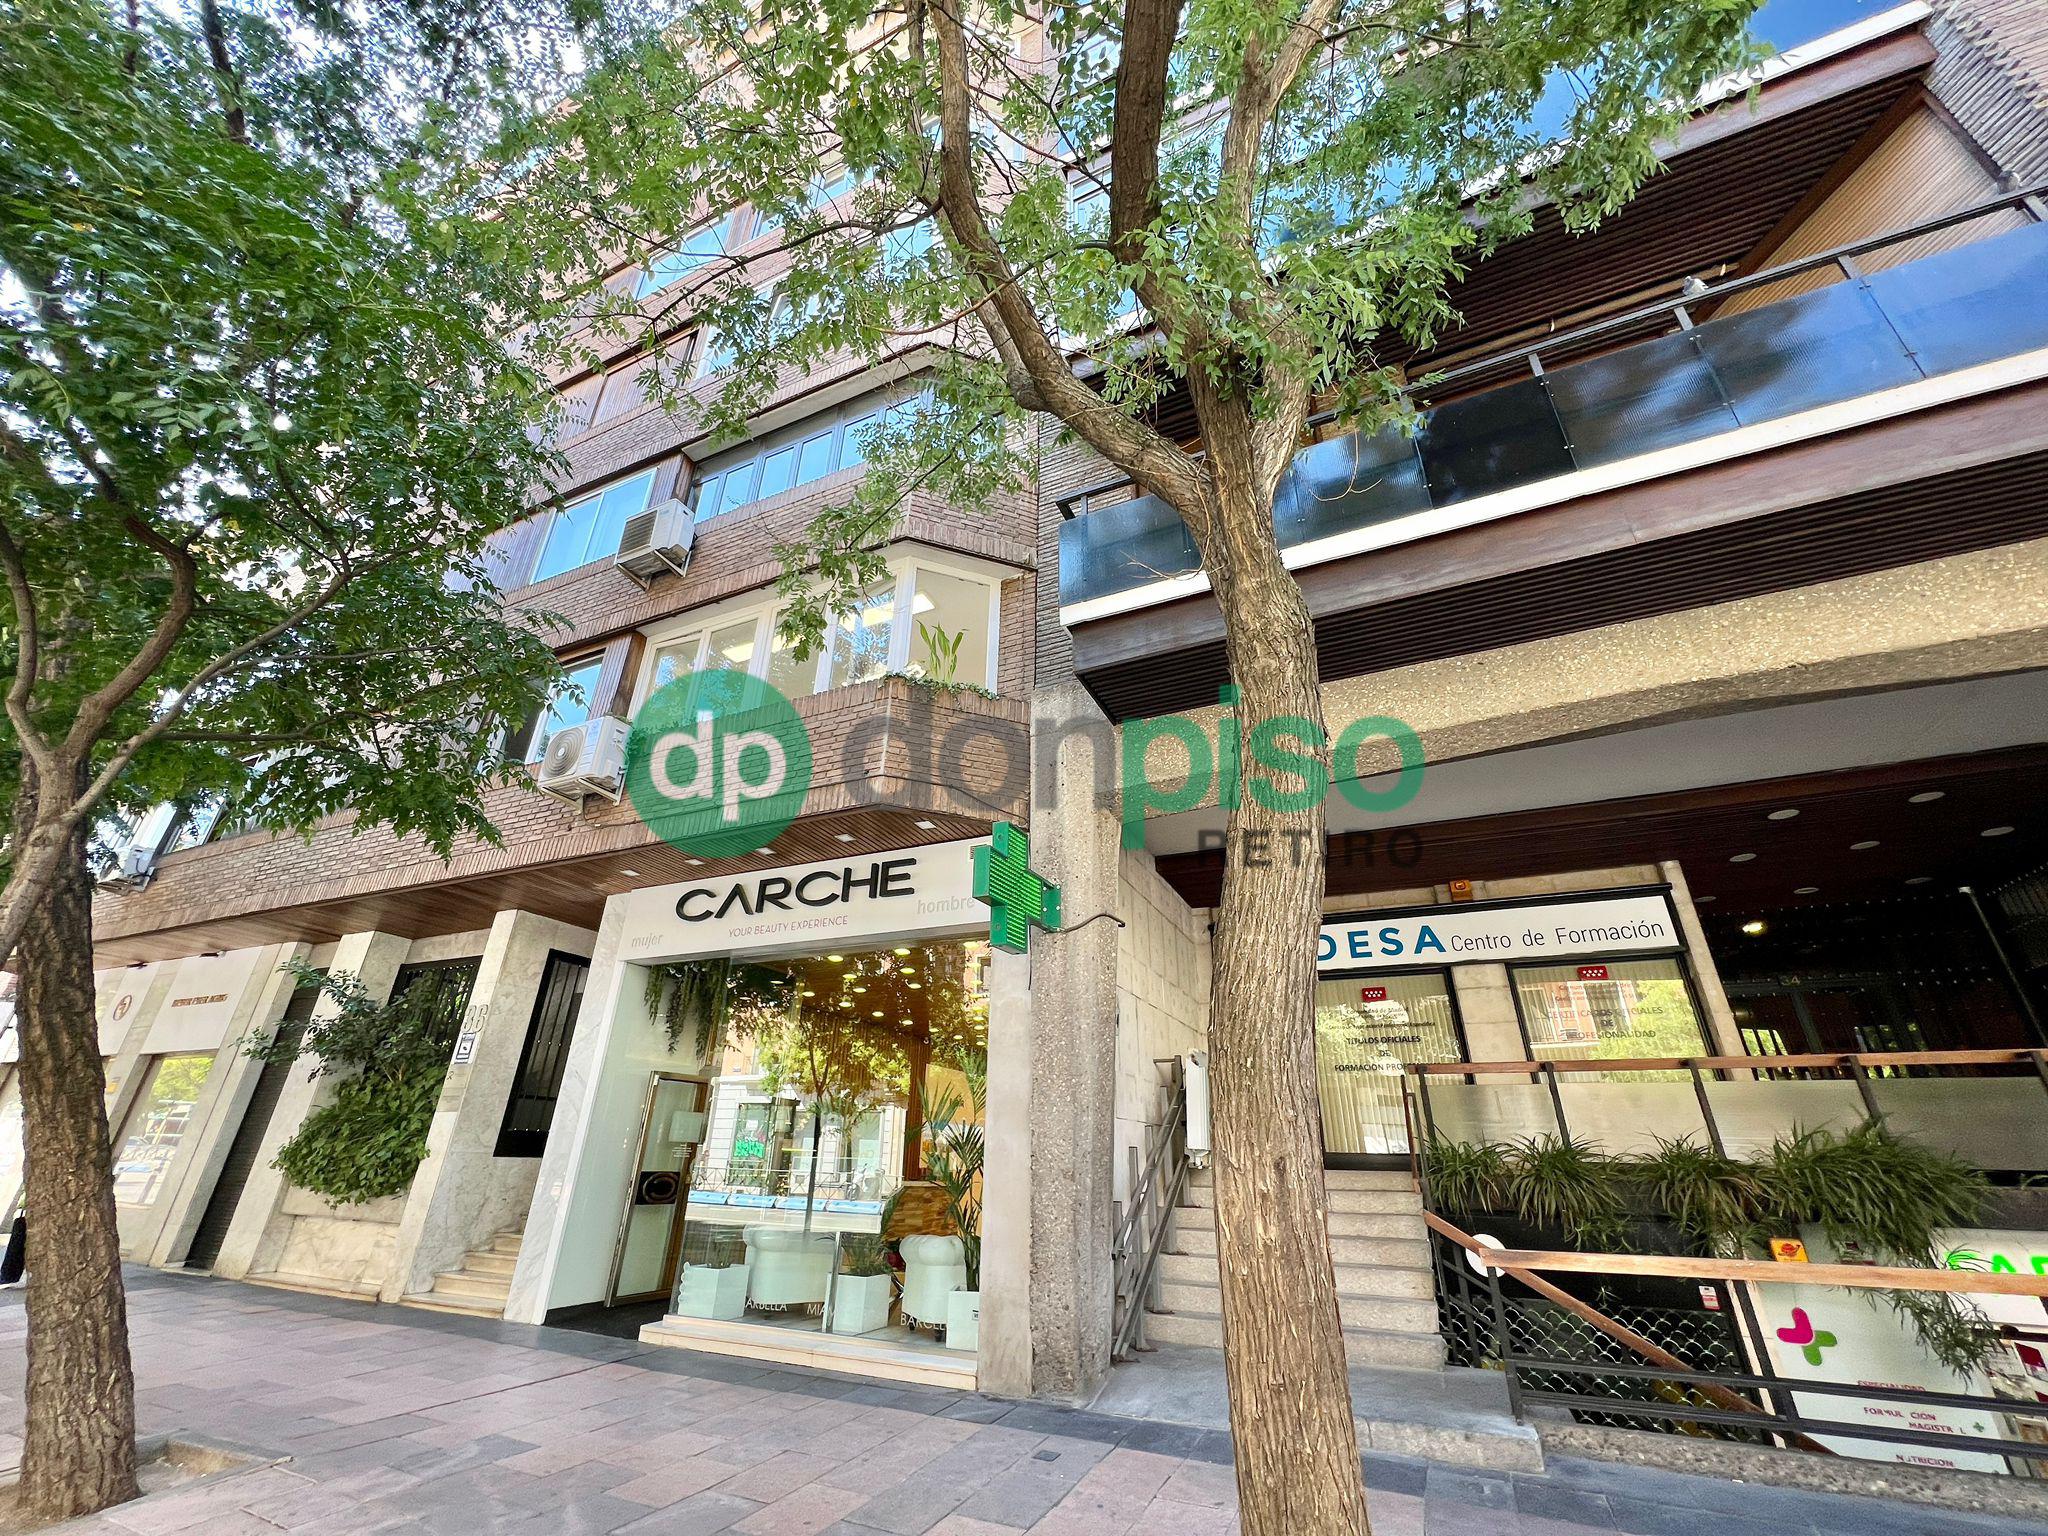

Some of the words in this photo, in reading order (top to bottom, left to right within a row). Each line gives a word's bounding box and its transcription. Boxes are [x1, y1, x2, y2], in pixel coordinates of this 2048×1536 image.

[675, 857, 917, 922] CARCHE
[917, 896, 975, 914] hombre
[728, 927, 752, 938] YOUR
[754, 922, 788, 935] BEAUTY
[790, 915, 849, 931] EXPERIENCE
[1450, 931, 1512, 952] Centro
[1522, 929, 1545, 946] de
[1554, 920, 1665, 945] Formación
[631, 933, 664, 949] mujer
[745, 1298, 788, 1312] ARBELLA
